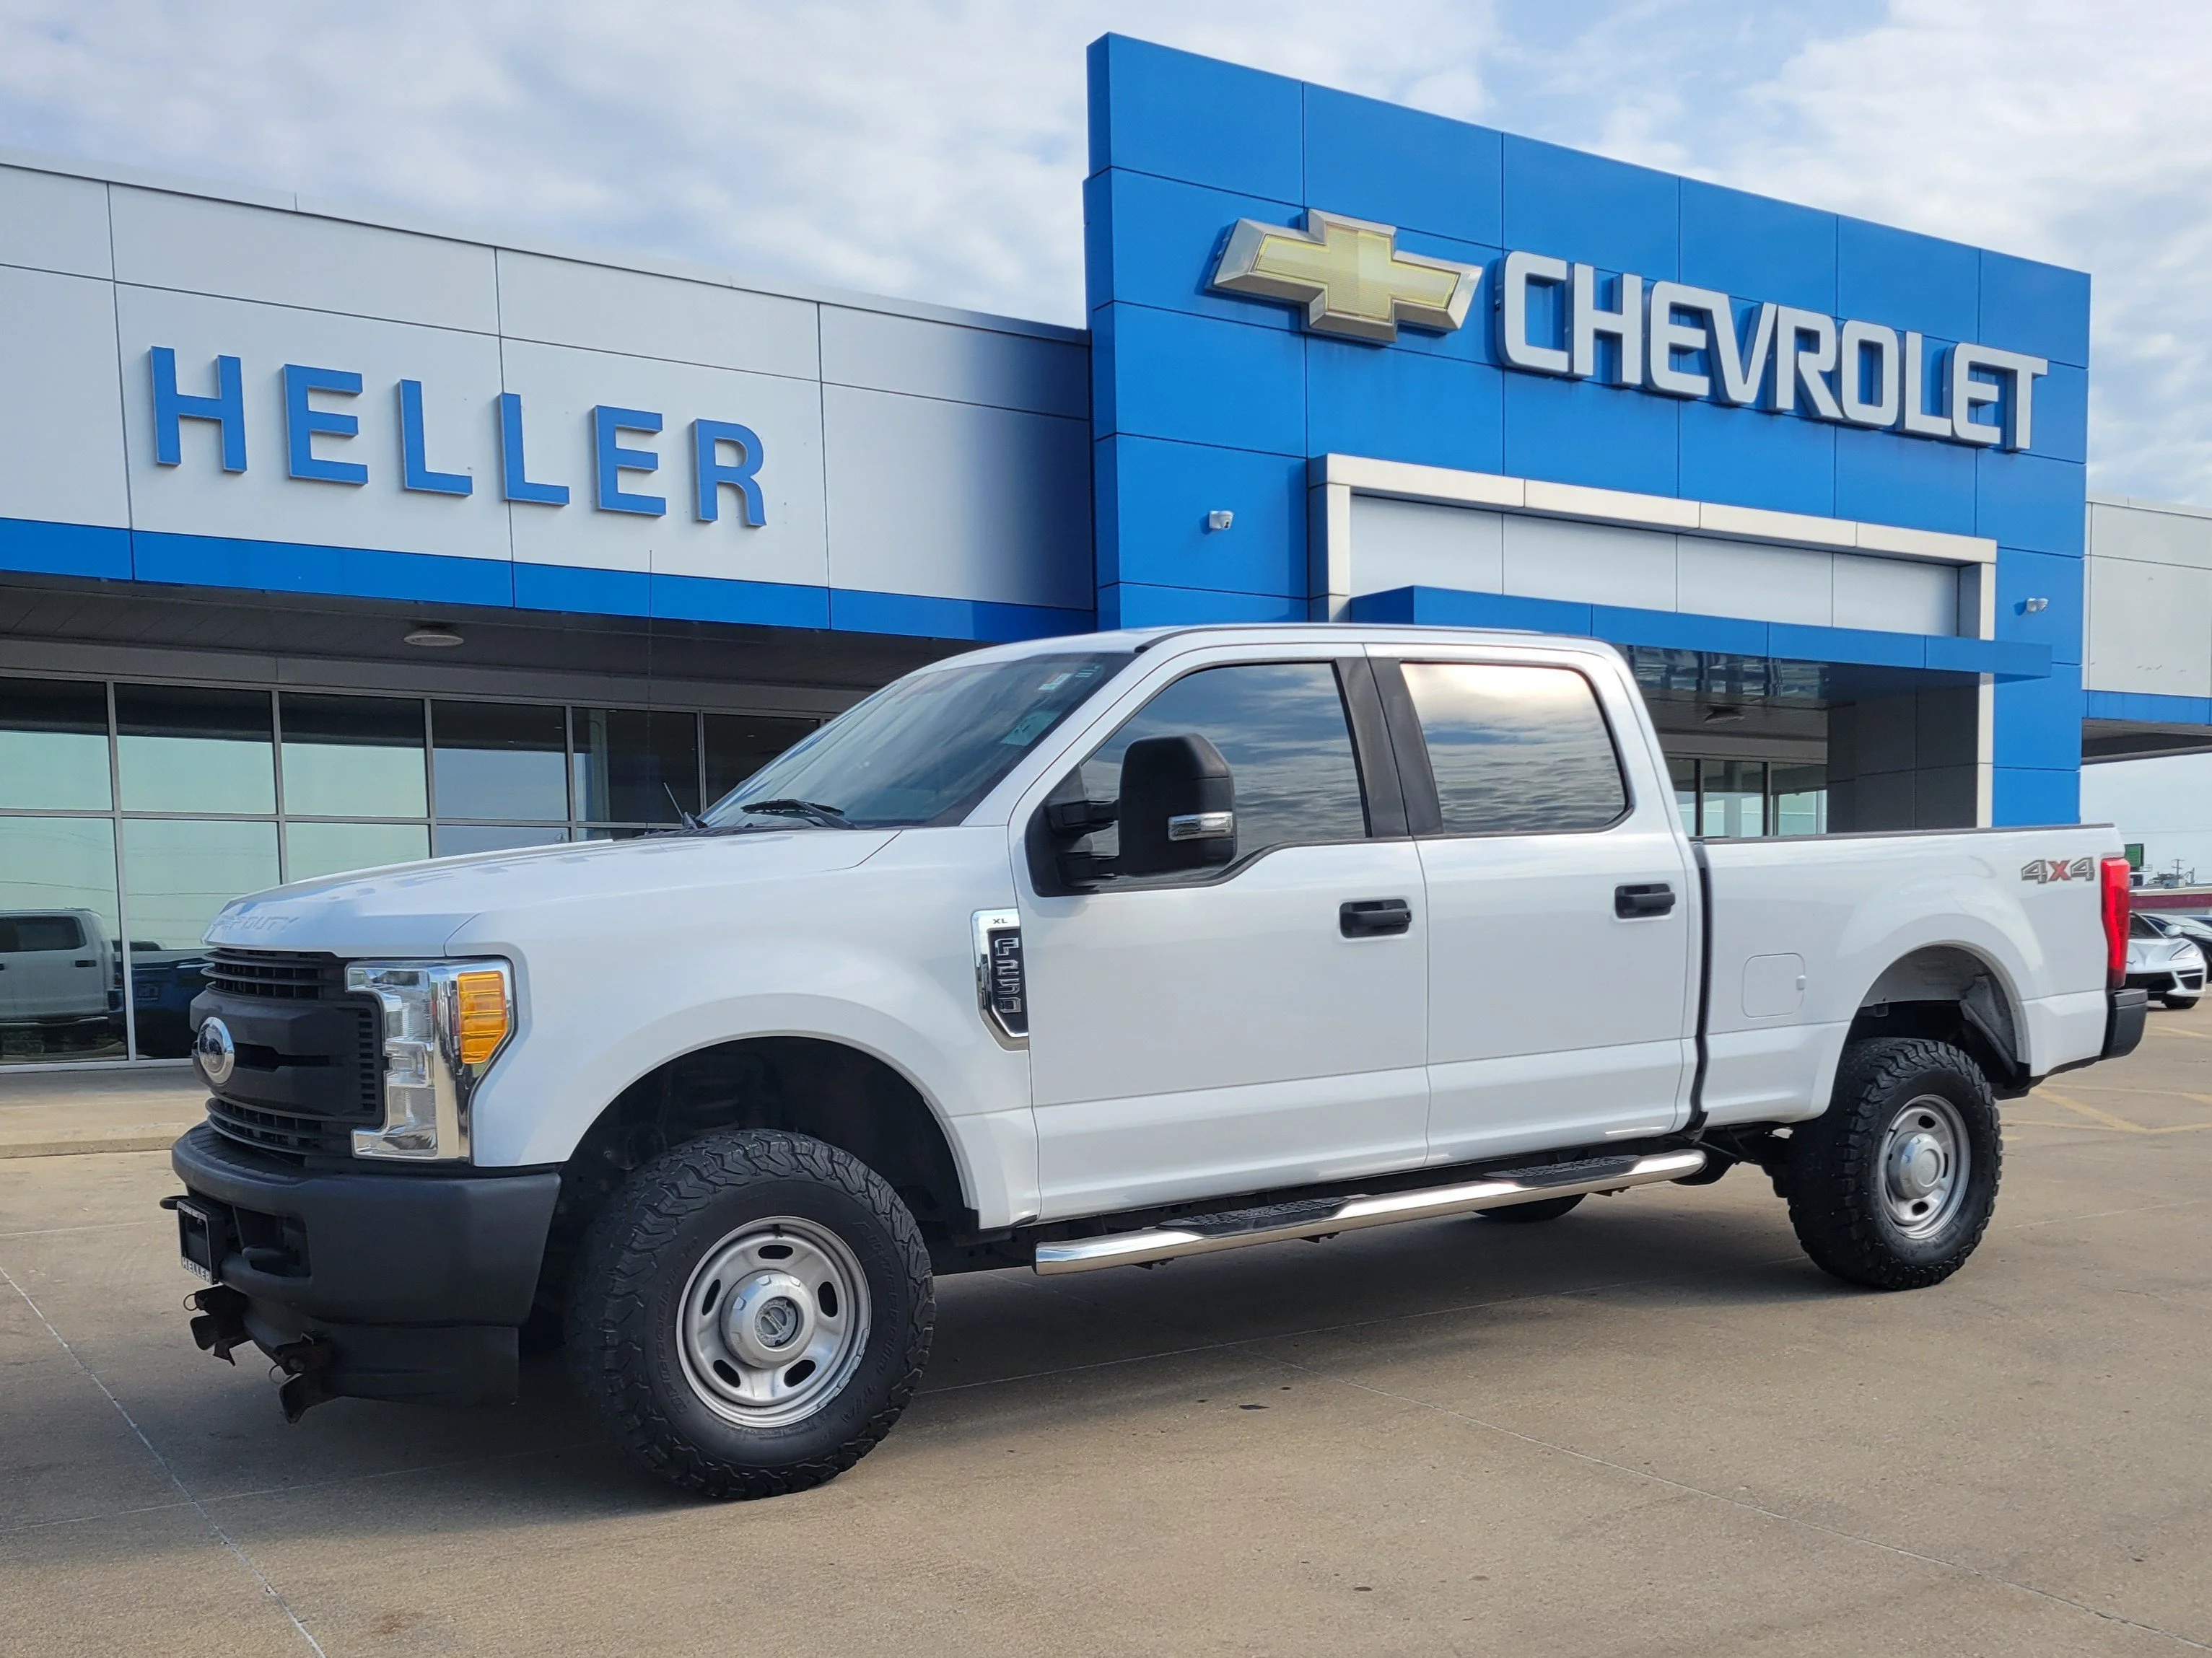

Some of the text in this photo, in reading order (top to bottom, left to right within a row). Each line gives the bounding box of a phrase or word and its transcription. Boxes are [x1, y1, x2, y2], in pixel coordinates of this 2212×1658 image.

[1497, 250, 2048, 451] CHEVROLET
[149, 346, 767, 527] HELLER
[2021, 856, 2096, 885] 4X4
[182, 1256, 211, 1284] HELLER
